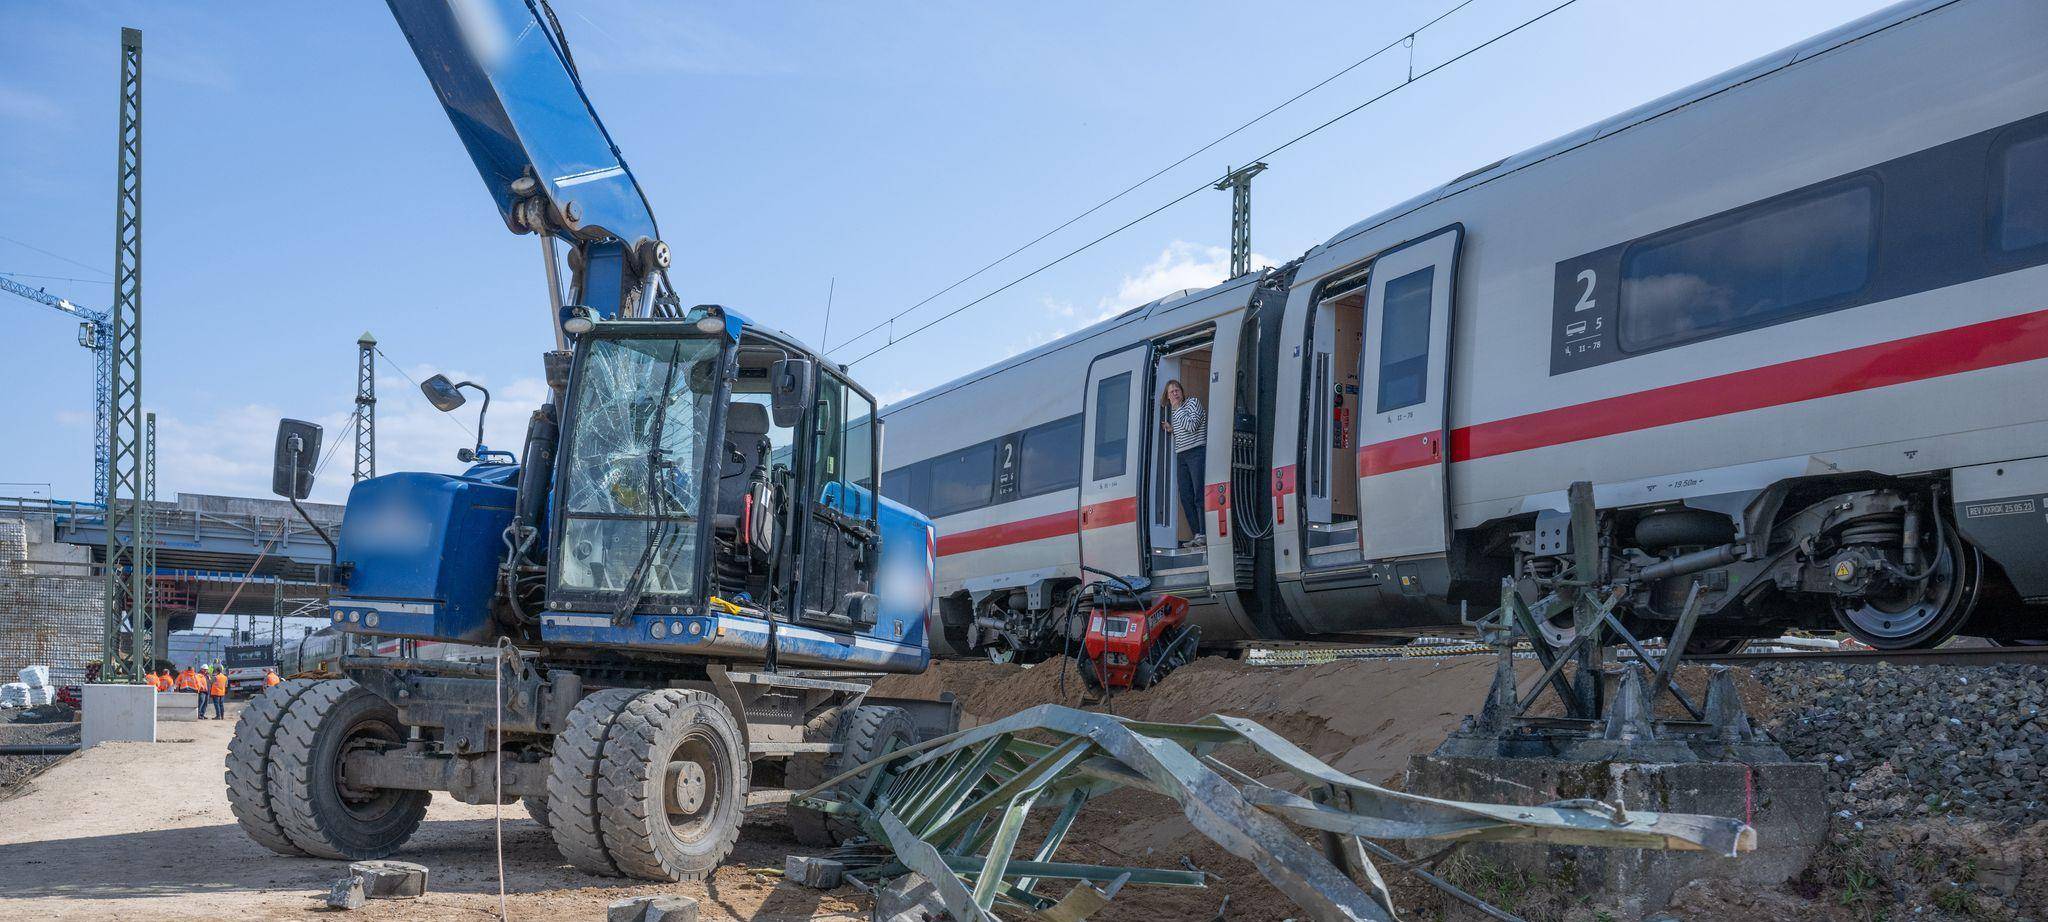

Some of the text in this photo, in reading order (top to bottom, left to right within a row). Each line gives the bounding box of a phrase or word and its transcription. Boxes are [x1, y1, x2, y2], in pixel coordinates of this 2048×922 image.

[1575, 269, 1597, 312] 2
[1596, 317, 1602, 330] 5
[1004, 443, 1013, 468] 2
